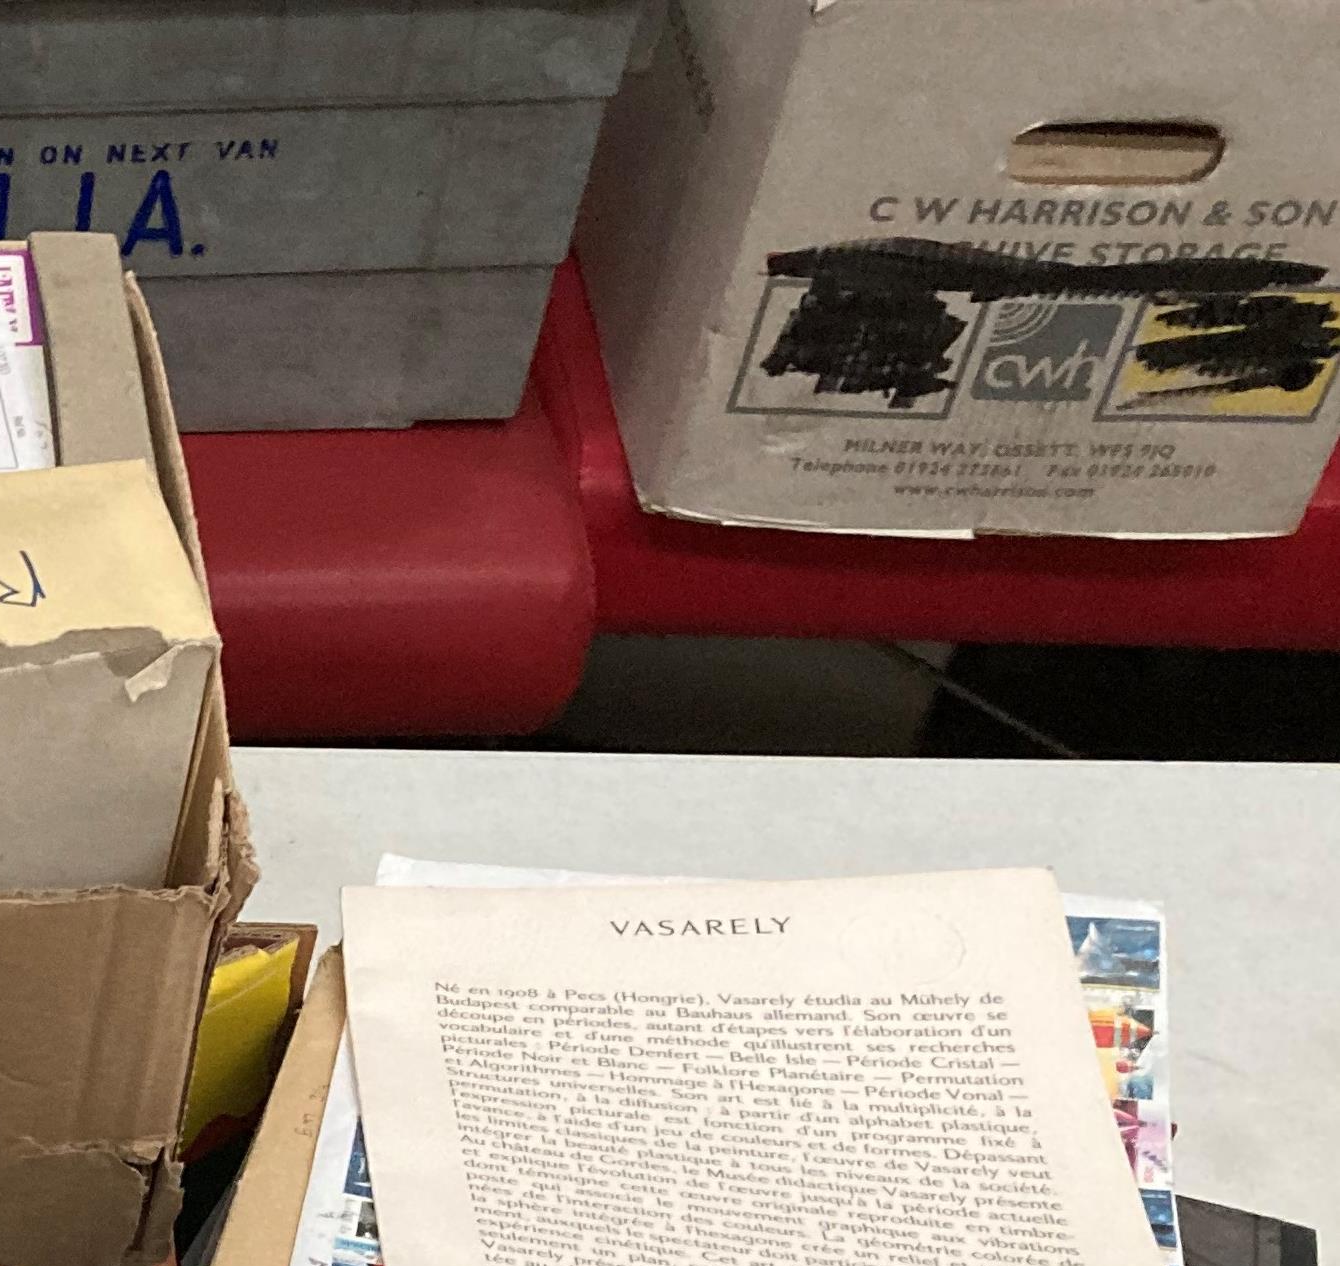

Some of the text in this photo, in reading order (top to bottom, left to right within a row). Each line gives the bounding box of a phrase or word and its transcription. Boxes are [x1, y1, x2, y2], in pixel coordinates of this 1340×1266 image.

[39, 144, 84, 166] ON
[105, 141, 192, 165] NEXT
[216, 138, 280, 161] VAN
[869, 196, 898, 223] C
[914, 196, 956, 224] W
[967, 199, 1194, 226] HARRISON
[1202, 199, 1234, 226] &
[610, 916, 791, 936] VASARELY
[718, 993, 795, 1010] Vasarely
[870, 997, 893, 1006] au
[979, 993, 1004, 1004] de
[864, 1011, 900, 1021] Son
[987, 1012, 1008, 1020] se
